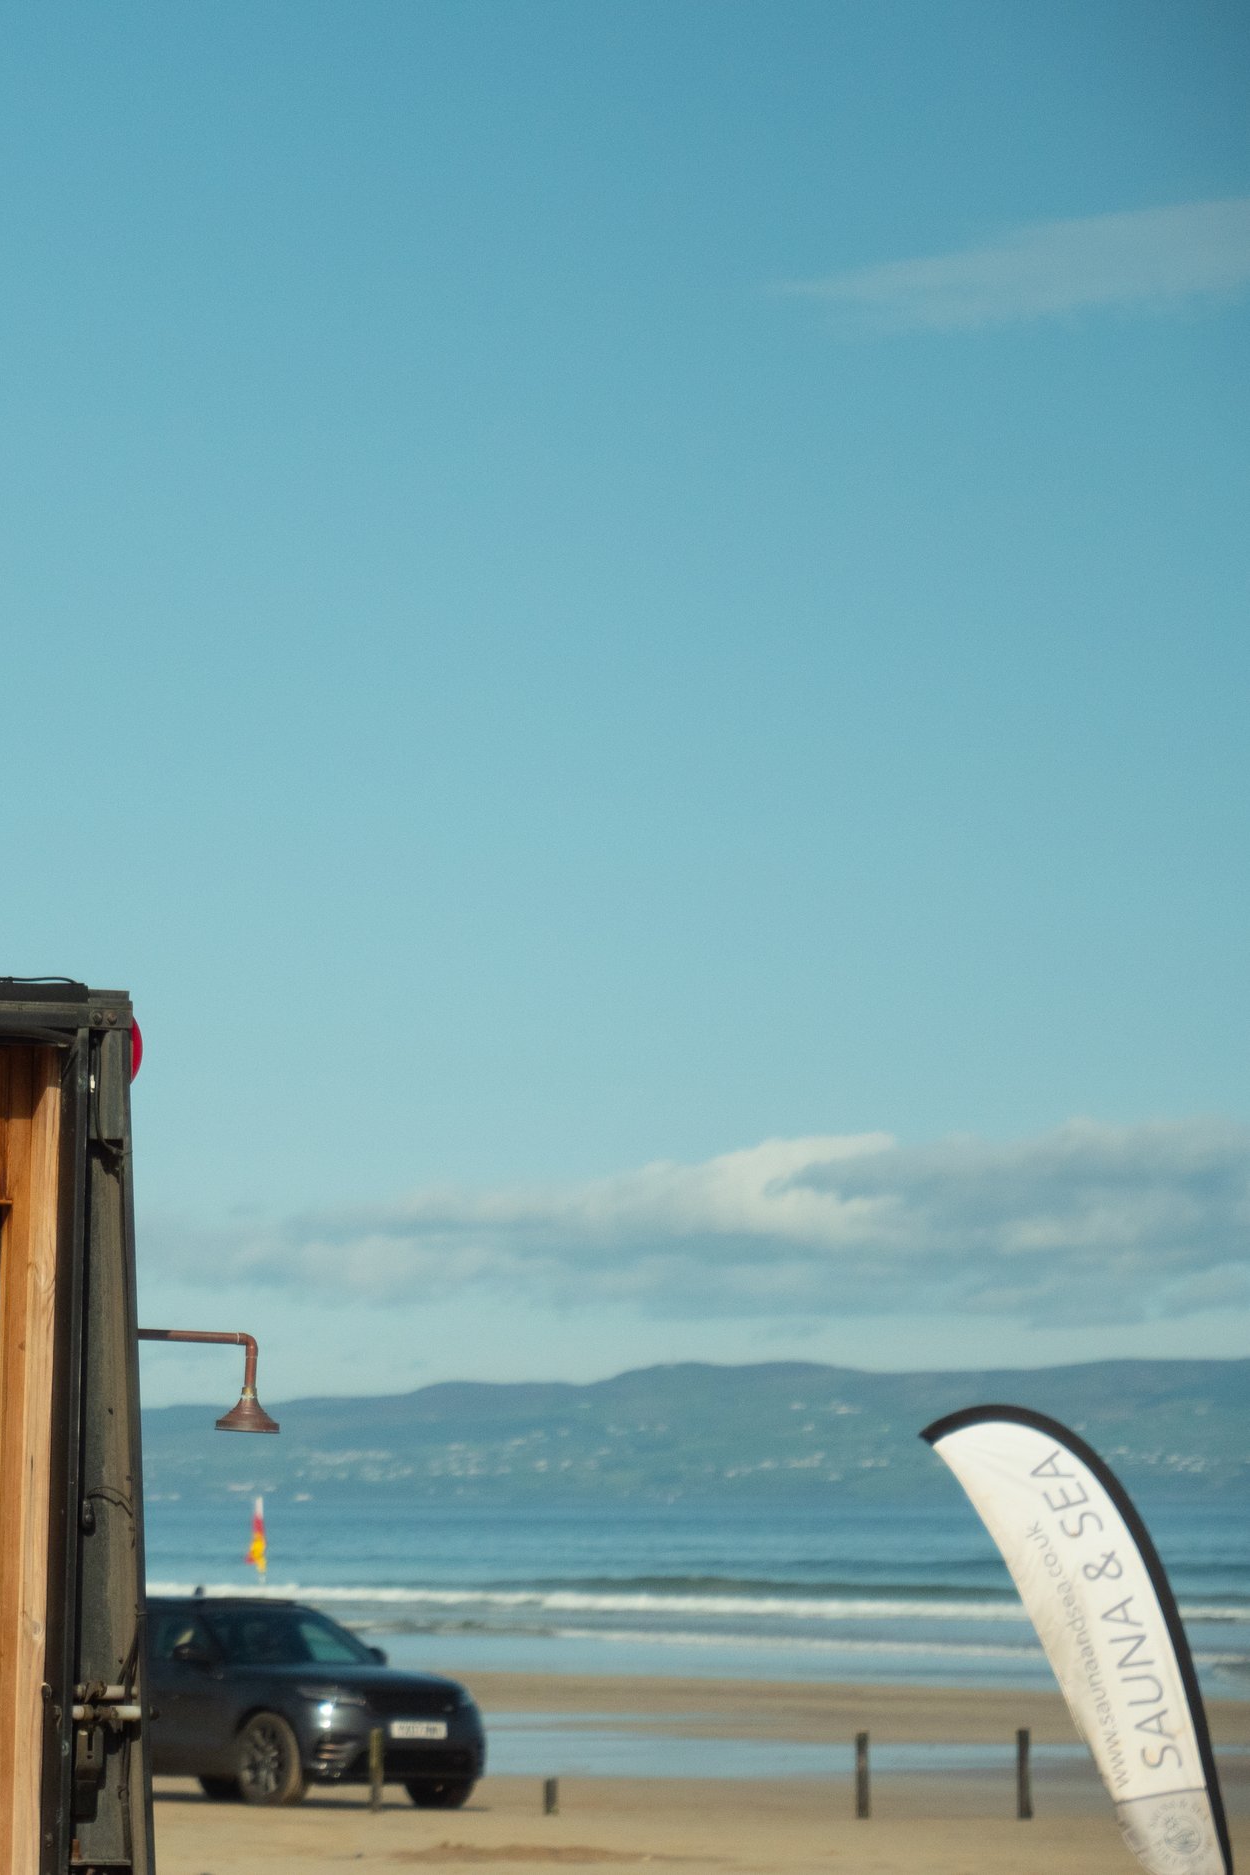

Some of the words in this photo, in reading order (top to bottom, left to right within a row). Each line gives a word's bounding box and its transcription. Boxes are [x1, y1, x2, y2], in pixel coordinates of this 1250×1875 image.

[1030, 1449, 1104, 1540] SEA
[1083, 1551, 1124, 1582] &
[1026, 1519, 1131, 1789] www.saunaandsea.co.uk
[1101, 1596, 1183, 1771] SAUNA
